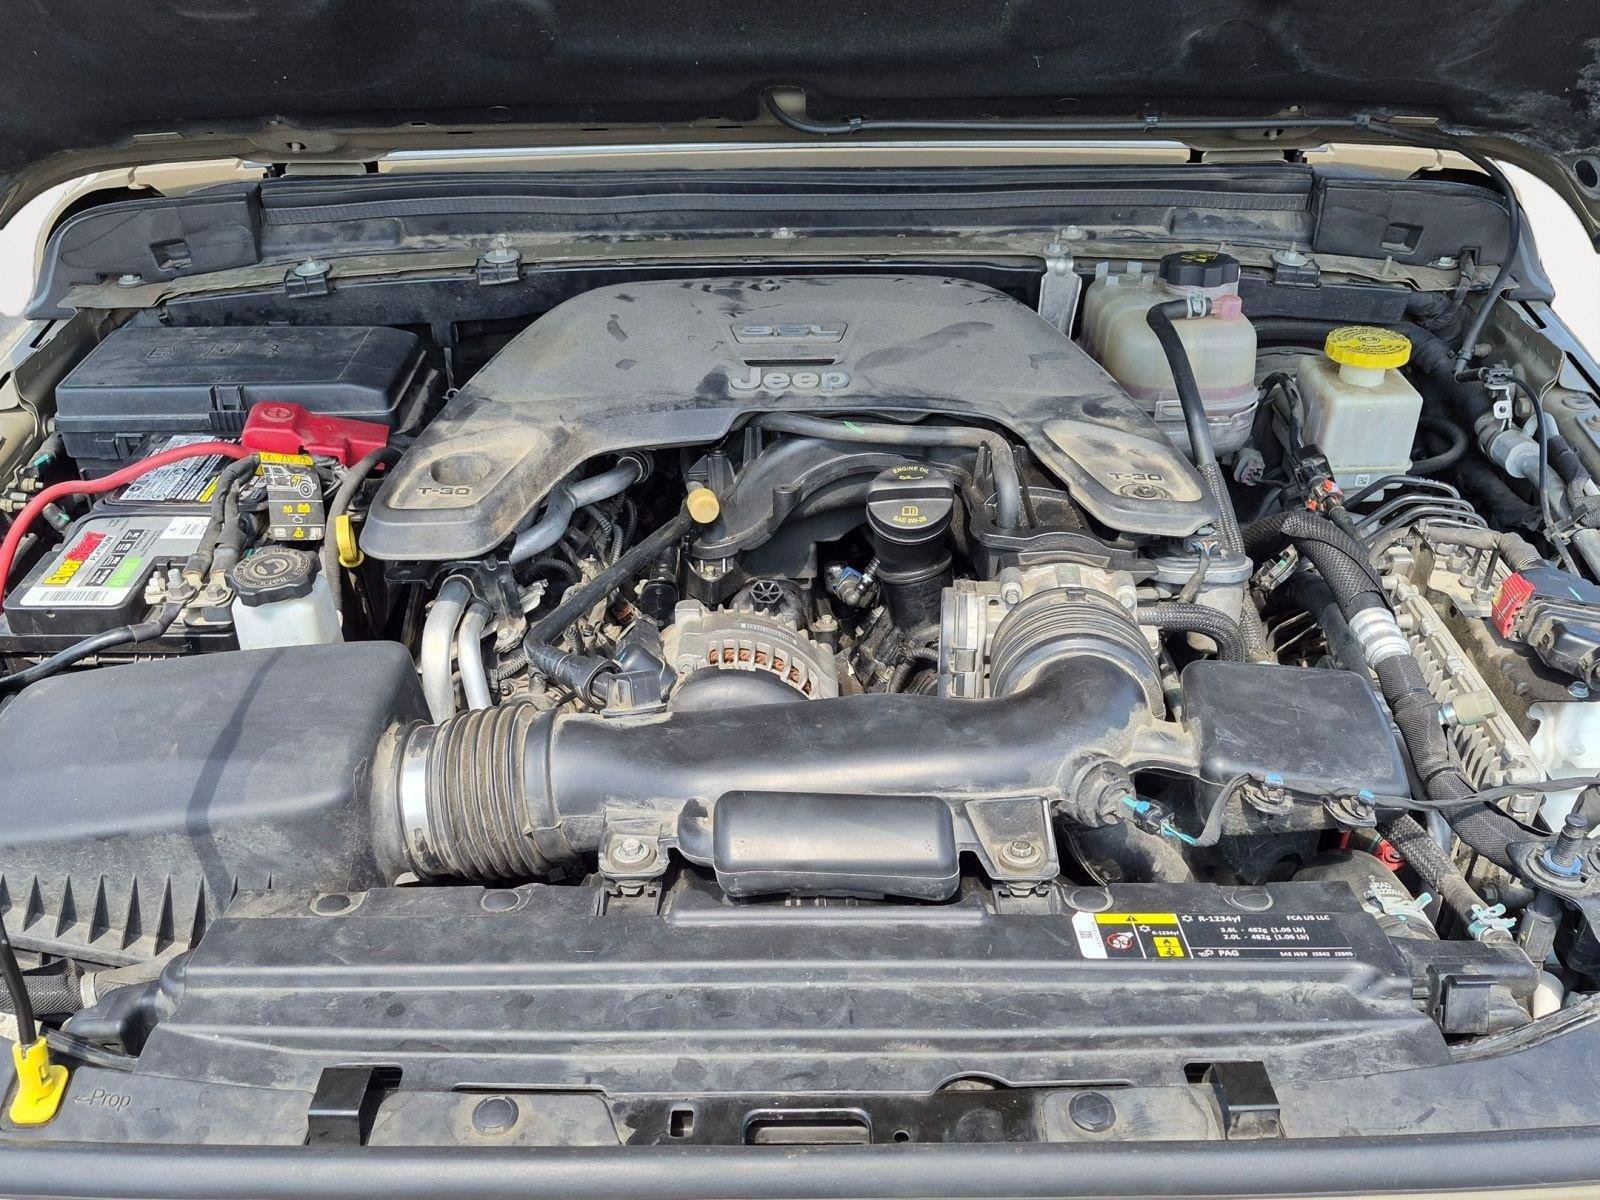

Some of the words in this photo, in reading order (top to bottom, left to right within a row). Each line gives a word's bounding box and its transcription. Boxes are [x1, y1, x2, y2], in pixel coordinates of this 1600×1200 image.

[730, 367, 850, 392] Jeep
[1109, 472, 1163, 481] T-30
[418, 487, 471, 495] T-30
[1198, 915, 1241, 923] R-1234yf
[1218, 949, 1240, 957] PAG
[89, 1088, 131, 1112] Prop
